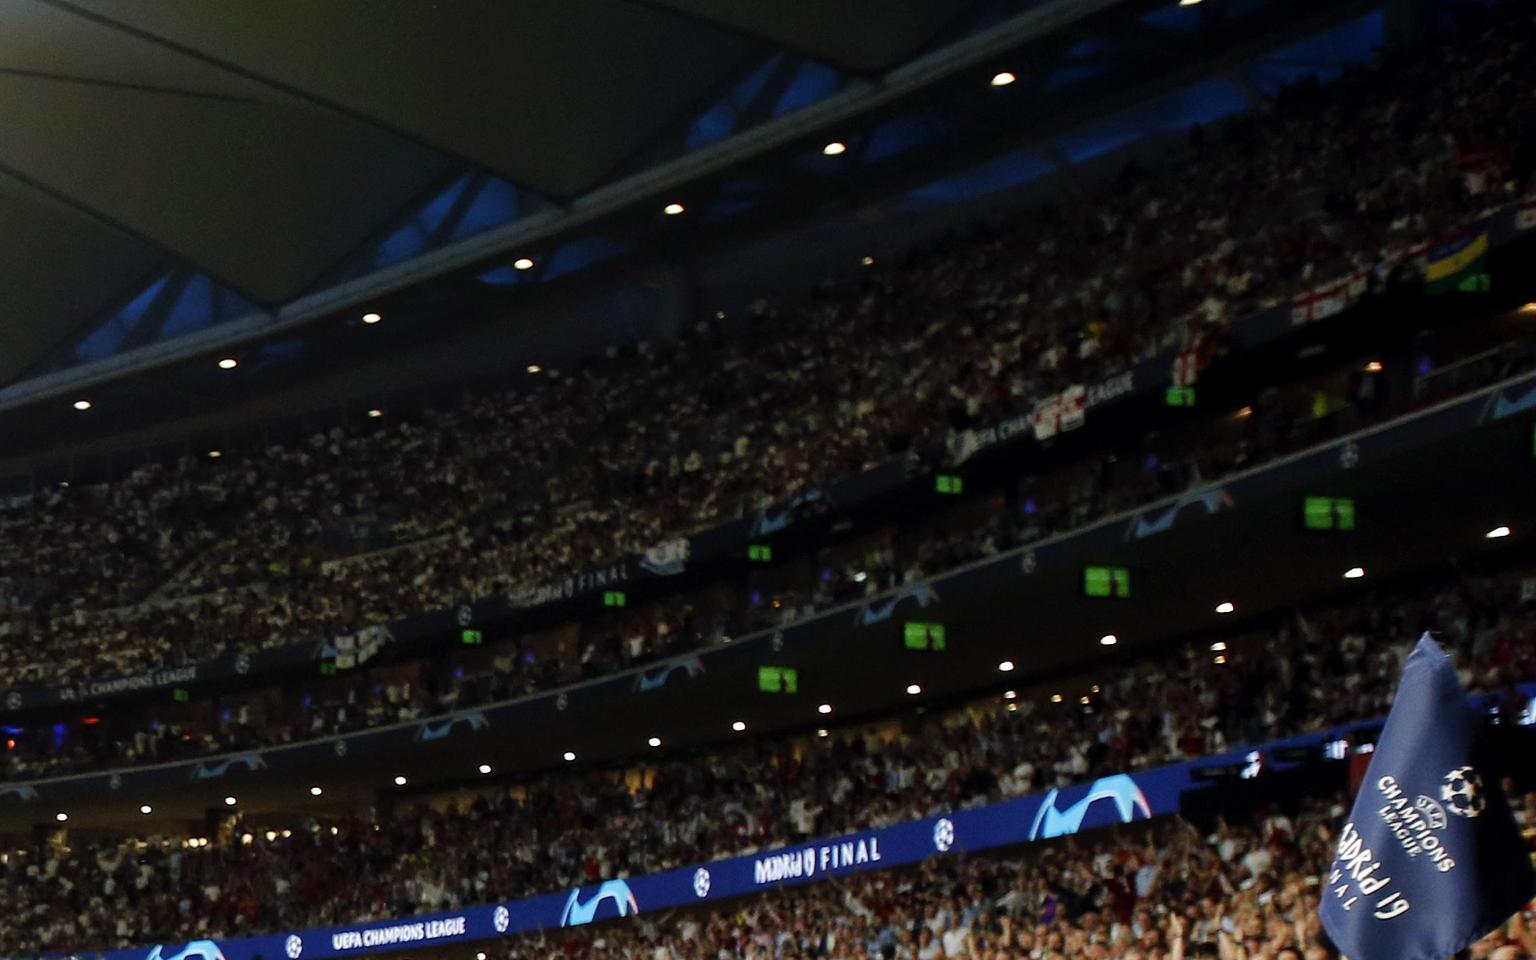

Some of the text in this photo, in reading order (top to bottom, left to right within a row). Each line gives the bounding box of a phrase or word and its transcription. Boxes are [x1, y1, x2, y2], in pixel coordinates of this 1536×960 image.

[1378, 775, 1456, 872] CHAMPIONS
[1378, 806, 1423, 857] LEAGUE
[820, 837, 881, 871] FINAL
[332, 916, 466, 950] UEFA CHAMPIONS LEAGUE
